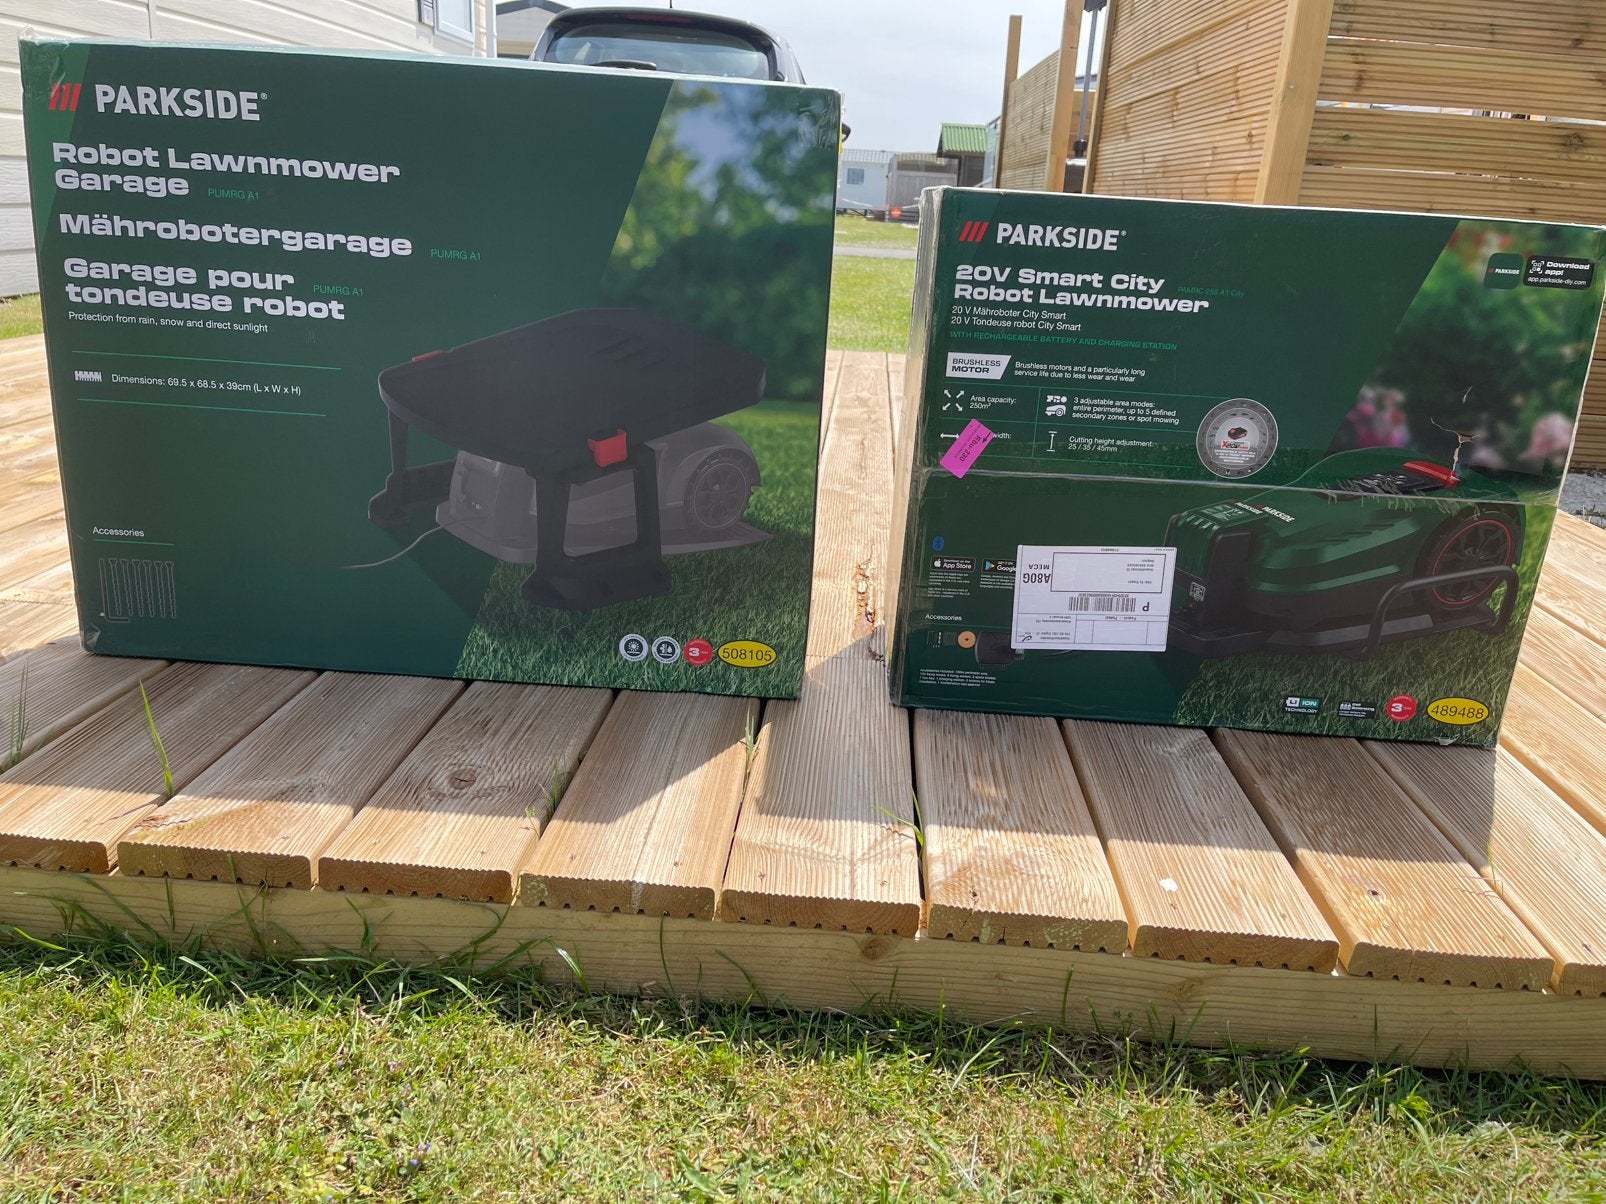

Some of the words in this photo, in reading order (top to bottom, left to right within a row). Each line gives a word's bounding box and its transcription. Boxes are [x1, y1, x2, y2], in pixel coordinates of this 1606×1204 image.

[52, 142, 160, 168] Robot
[168, 148, 401, 183] Lawnmower
[55, 169, 190, 197] Garage
[208, 188, 245, 200] PUMRG
[248, 190, 260, 200] A1
[59, 213, 413, 257] Mährobotergarage
[430, 248, 467, 260] PUMRG
[470, 252, 481, 260] A1
[1546, 262, 1590, 270] Download
[64, 257, 197, 289] Garage
[208, 269, 294, 290] pour
[956, 264, 1012, 282] 20V
[1018, 268, 1103, 288] Smart
[1110, 274, 1165, 294] City
[1528, 276, 1586, 286] app.parkside-diy.com
[313, 284, 350, 296] PUMRG
[352, 286, 364, 296] A1
[66, 283, 233, 312] tondeuse
[243, 297, 345, 320] robot
[954, 284, 1034, 303] Robot
[1039, 288, 1210, 313] Lawnmower
[952, 306, 964, 314] 20
[964, 306, 971, 314] V
[972, 306, 1020, 317] Mähroboter
[1022, 309, 1040, 320] City
[1041, 310, 1066, 320] Smart
[68, 311, 112, 324] Protection
[116, 314, 136, 324] from
[138, 315, 158, 326] rain,
[160, 318, 184, 326] snow
[186, 318, 203, 328] and
[206, 319, 231, 330] direct
[233, 320, 268, 333] sunlight
[951, 316, 963, 325] 20
[964, 317, 971, 326] V
[972, 318, 1012, 327] Tondeuse
[1013, 320, 1036, 328] robot
[1038, 320, 1054, 332] City
[1056, 322, 1081, 331] Smart
[950, 330, 972, 339] WITH
[974, 332, 1038, 342] RECHARGEABLE
[1040, 335, 1077, 344] BATTERY
[1080, 338, 1096, 346] AND
[1098, 338, 1140, 348] CHARGING
[1142, 342, 1178, 350] STATION
[952, 358, 1000, 366] BRUSHLESS
[952, 365, 990, 374] MOTOR
[1016, 362, 1048, 370] Brushless
[1093, 367, 1130, 376] particularly
[1130, 368, 1146, 376] long
[1038, 370, 1049, 378] life
[1050, 370, 1063, 378] due
[1072, 372, 1086, 380] less
[1104, 374, 1118, 382] and
[112, 374, 166, 386] Dimensions:
[168, 377, 188, 388] 69.5
[197, 378, 217, 389] 68.5
[218, 382, 225, 390] x
[226, 380, 251, 392] 39cm
[254, 382, 262, 394] (L
[272, 384, 282, 394] W
[291, 385, 302, 396] H)
[987, 396, 1016, 405] capacity:
[1080, 397, 1114, 406] adjustable
[1094, 406, 1126, 414] perimeter,
[1151, 408, 1176, 416] defined
[1072, 412, 1106, 420] secondary
[1152, 417, 1180, 425] mowing
[1070, 436, 1094, 445] Cutting
[1096, 437, 1116, 446] height
[1116, 438, 1154, 448] adjustment:
[92, 526, 144, 537] Accessories
[1022, 573, 1051, 584] A80G
[1142, 602, 1150, 612] P
[925, 614, 962, 622] Accessories
[722, 648, 772, 662] 508105
[1391, 703, 1402, 712] 3
[1431, 705, 1484, 720] 489488
